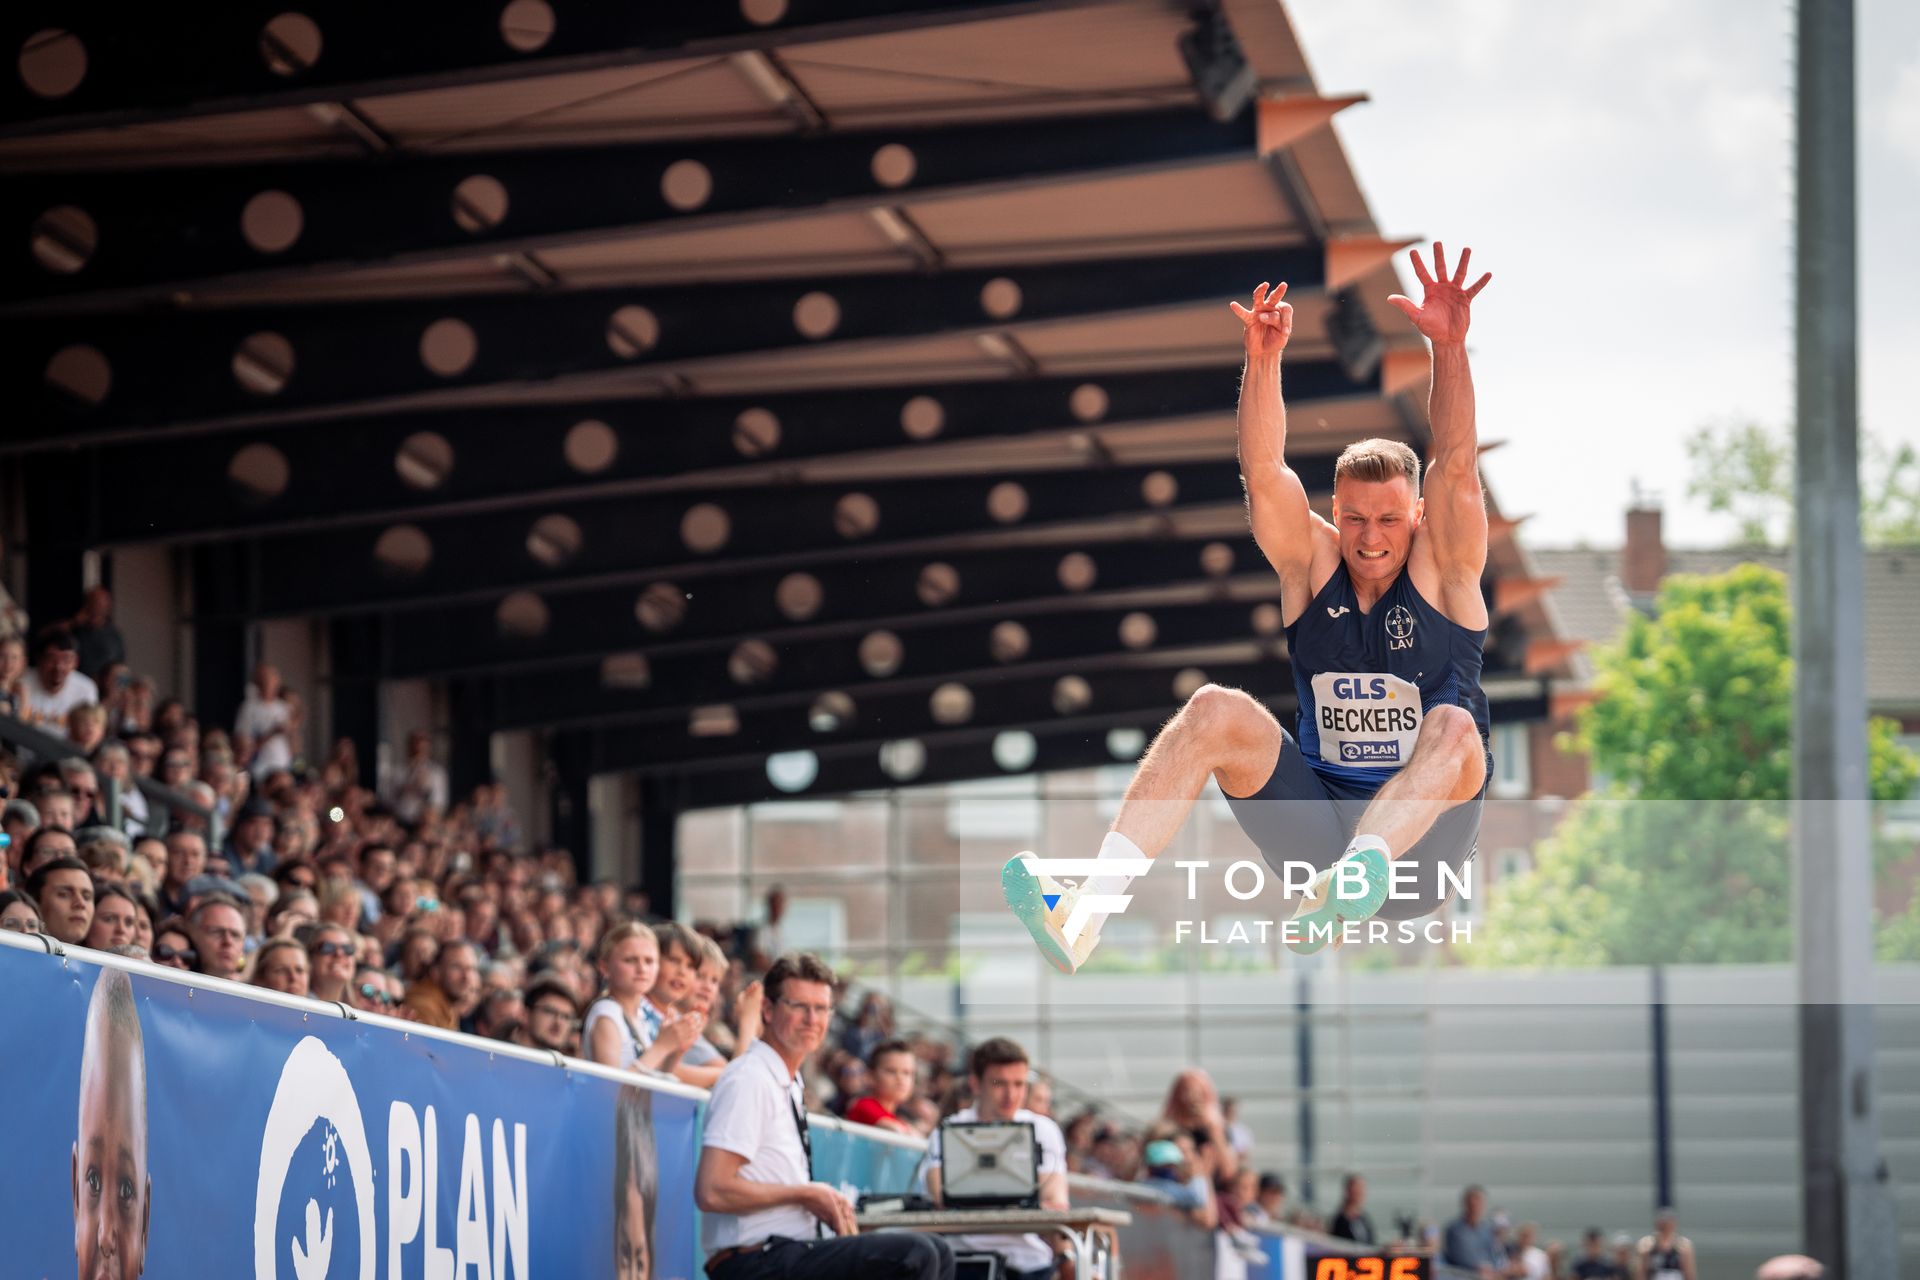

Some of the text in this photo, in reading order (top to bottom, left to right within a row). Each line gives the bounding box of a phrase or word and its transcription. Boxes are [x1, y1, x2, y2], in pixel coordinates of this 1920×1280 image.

[1390, 638, 1413, 650] LAV
[1322, 706, 1417, 732] BECKERS
[1363, 745, 1397, 755] PLAN
[388, 1100, 529, 1280] PLAN
